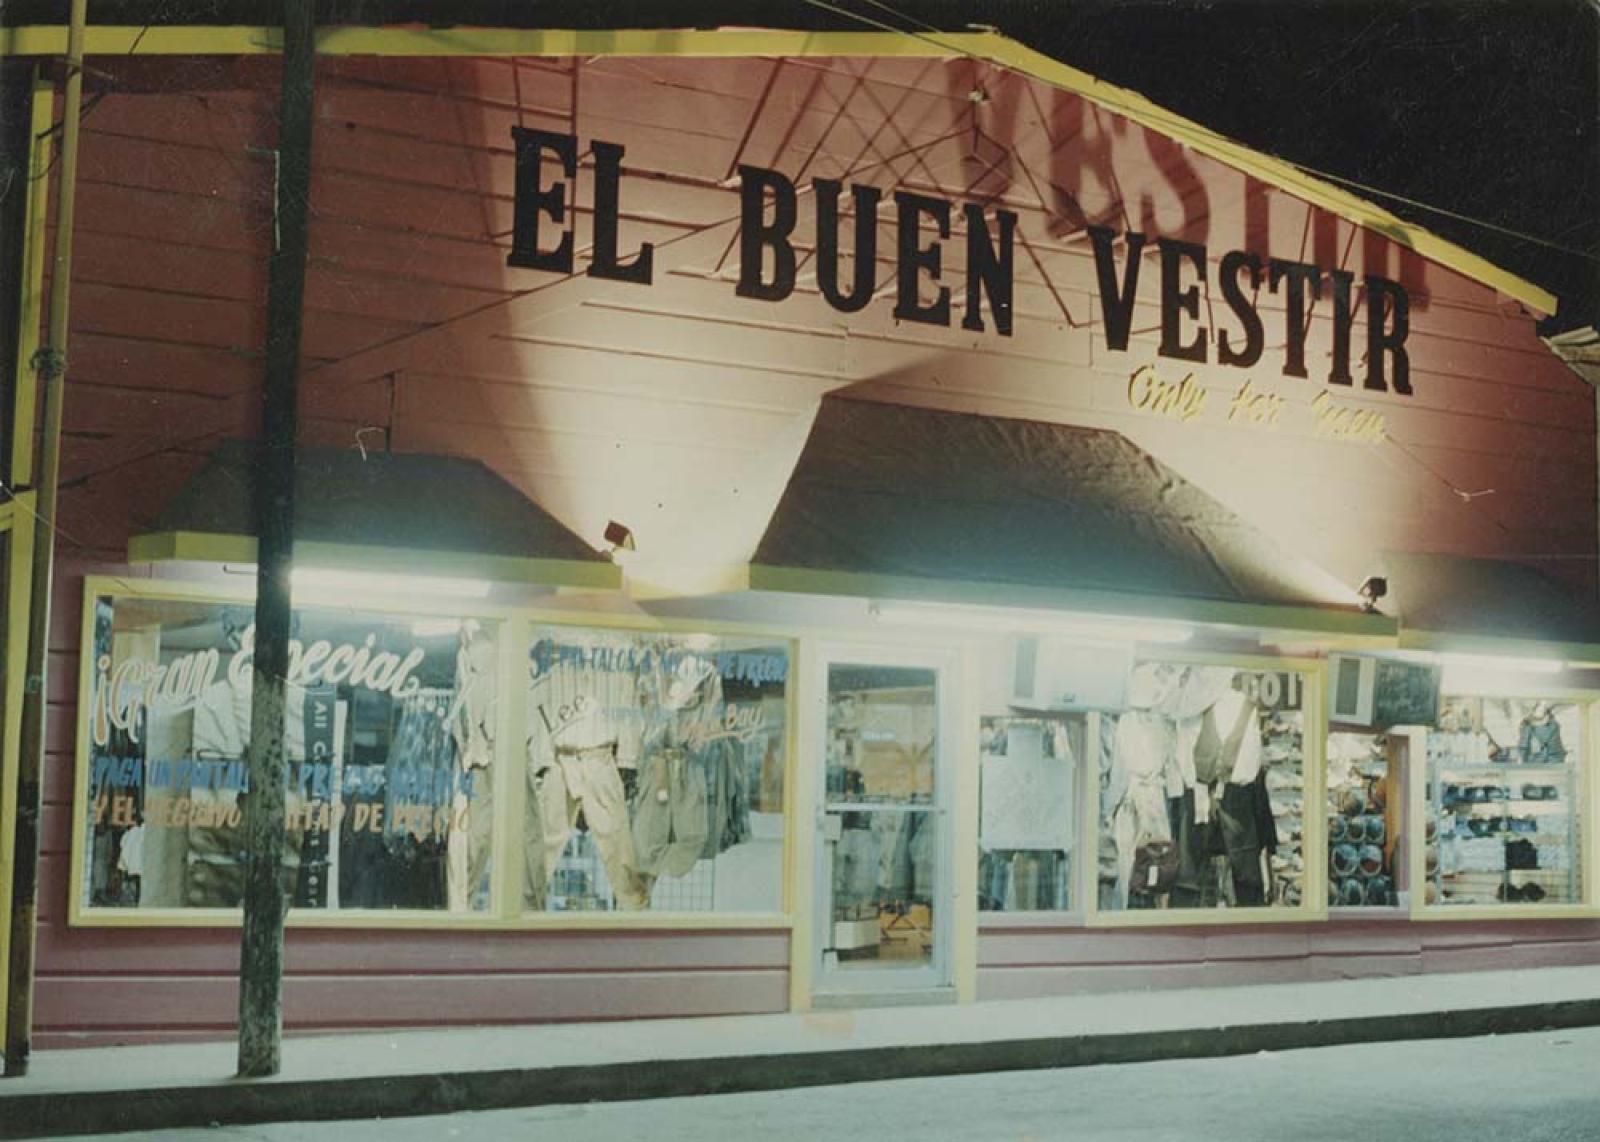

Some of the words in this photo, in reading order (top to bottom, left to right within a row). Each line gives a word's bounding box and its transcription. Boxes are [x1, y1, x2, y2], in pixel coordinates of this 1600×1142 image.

[506, 126, 653, 285] EL
[735, 164, 1019, 337] BUEN
[1086, 223, 1414, 397] VESTIR
[1128, 363, 1207, 421] Only
[537, 695, 589, 735] Lee
[352, 802, 385, 833] DE
